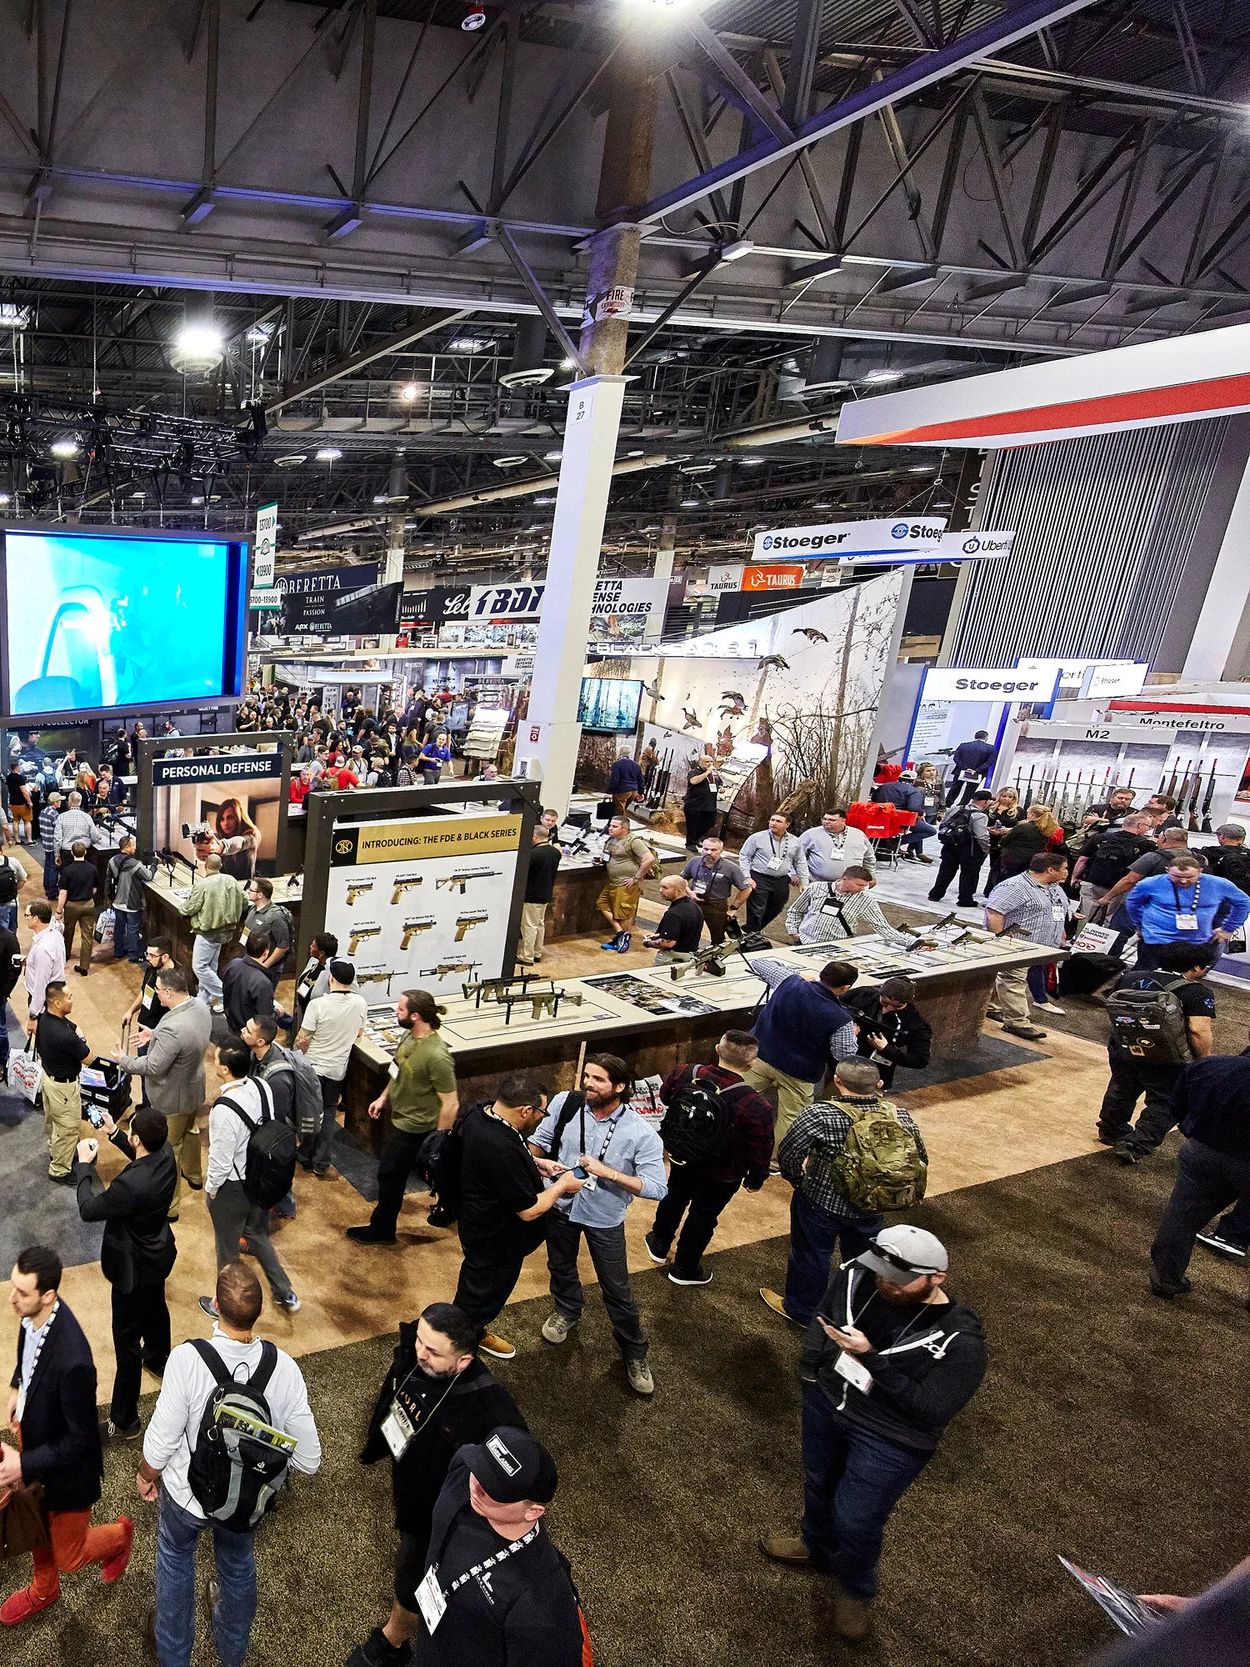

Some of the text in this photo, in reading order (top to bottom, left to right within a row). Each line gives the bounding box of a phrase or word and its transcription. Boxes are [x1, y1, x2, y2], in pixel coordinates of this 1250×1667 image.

[606, 289, 625, 301] FIRE
[576, 410, 586, 421] 27
[909, 524, 943, 543] Stoeg
[772, 532, 848, 549] Stoeger
[981, 540, 1012, 551] Ubert
[289, 574, 341, 594] BERETTA
[595, 580, 623, 591] ETTA
[710, 581, 738, 590] TAURUS
[765, 573, 797, 587] TAURUS
[250, 595, 278, 604] 3700-13900
[305, 595, 325, 604] TRAIN
[592, 591, 622, 603] ENSE
[303, 608, 326, 616] PASSION
[591, 602, 653, 614] HNOLOGIES
[955, 678, 1039, 693] Stoeger
[1085, 729, 1111, 740] M2
[161, 760, 272, 779] PERSONAL DEFENSE
[361, 836, 422, 850] INTRODUCING:
[423, 835, 439, 846] THE
[440, 833, 456, 844] FDE
[456, 833, 463, 842] &
[464, 830, 490, 842] BLACK
[490, 828, 517, 839] SERIES
